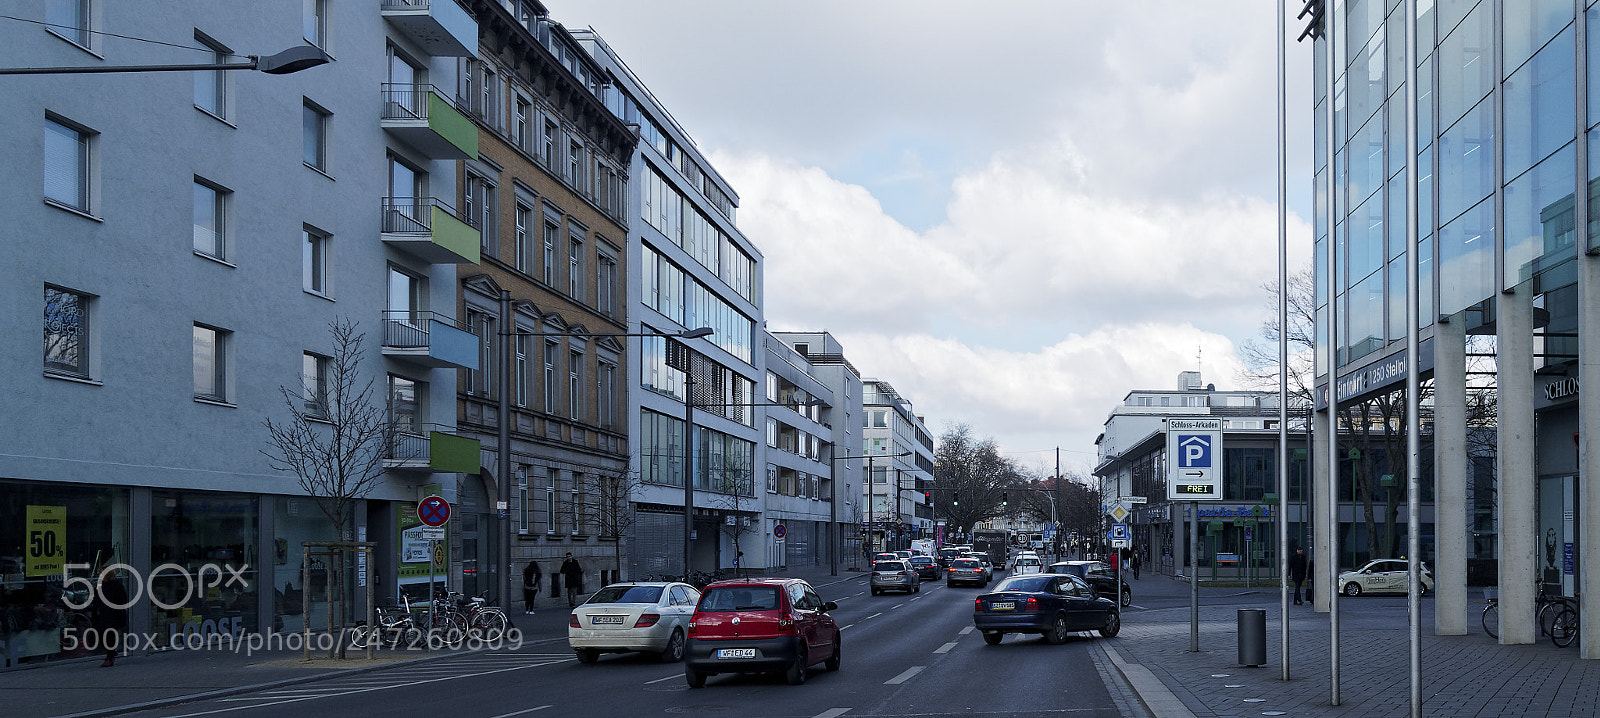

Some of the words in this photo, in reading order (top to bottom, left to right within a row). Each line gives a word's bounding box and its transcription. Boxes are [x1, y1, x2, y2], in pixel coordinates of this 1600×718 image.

[1171, 420, 1218, 429] Schloss-Arkaden
[1186, 445, 1203, 467] P
[1187, 485, 1208, 493] FREI
[1188, 507, 1270, 519] parda-Bak
[30, 530, 64, 557] 50%
[169, 616, 244, 649] LOOSE
